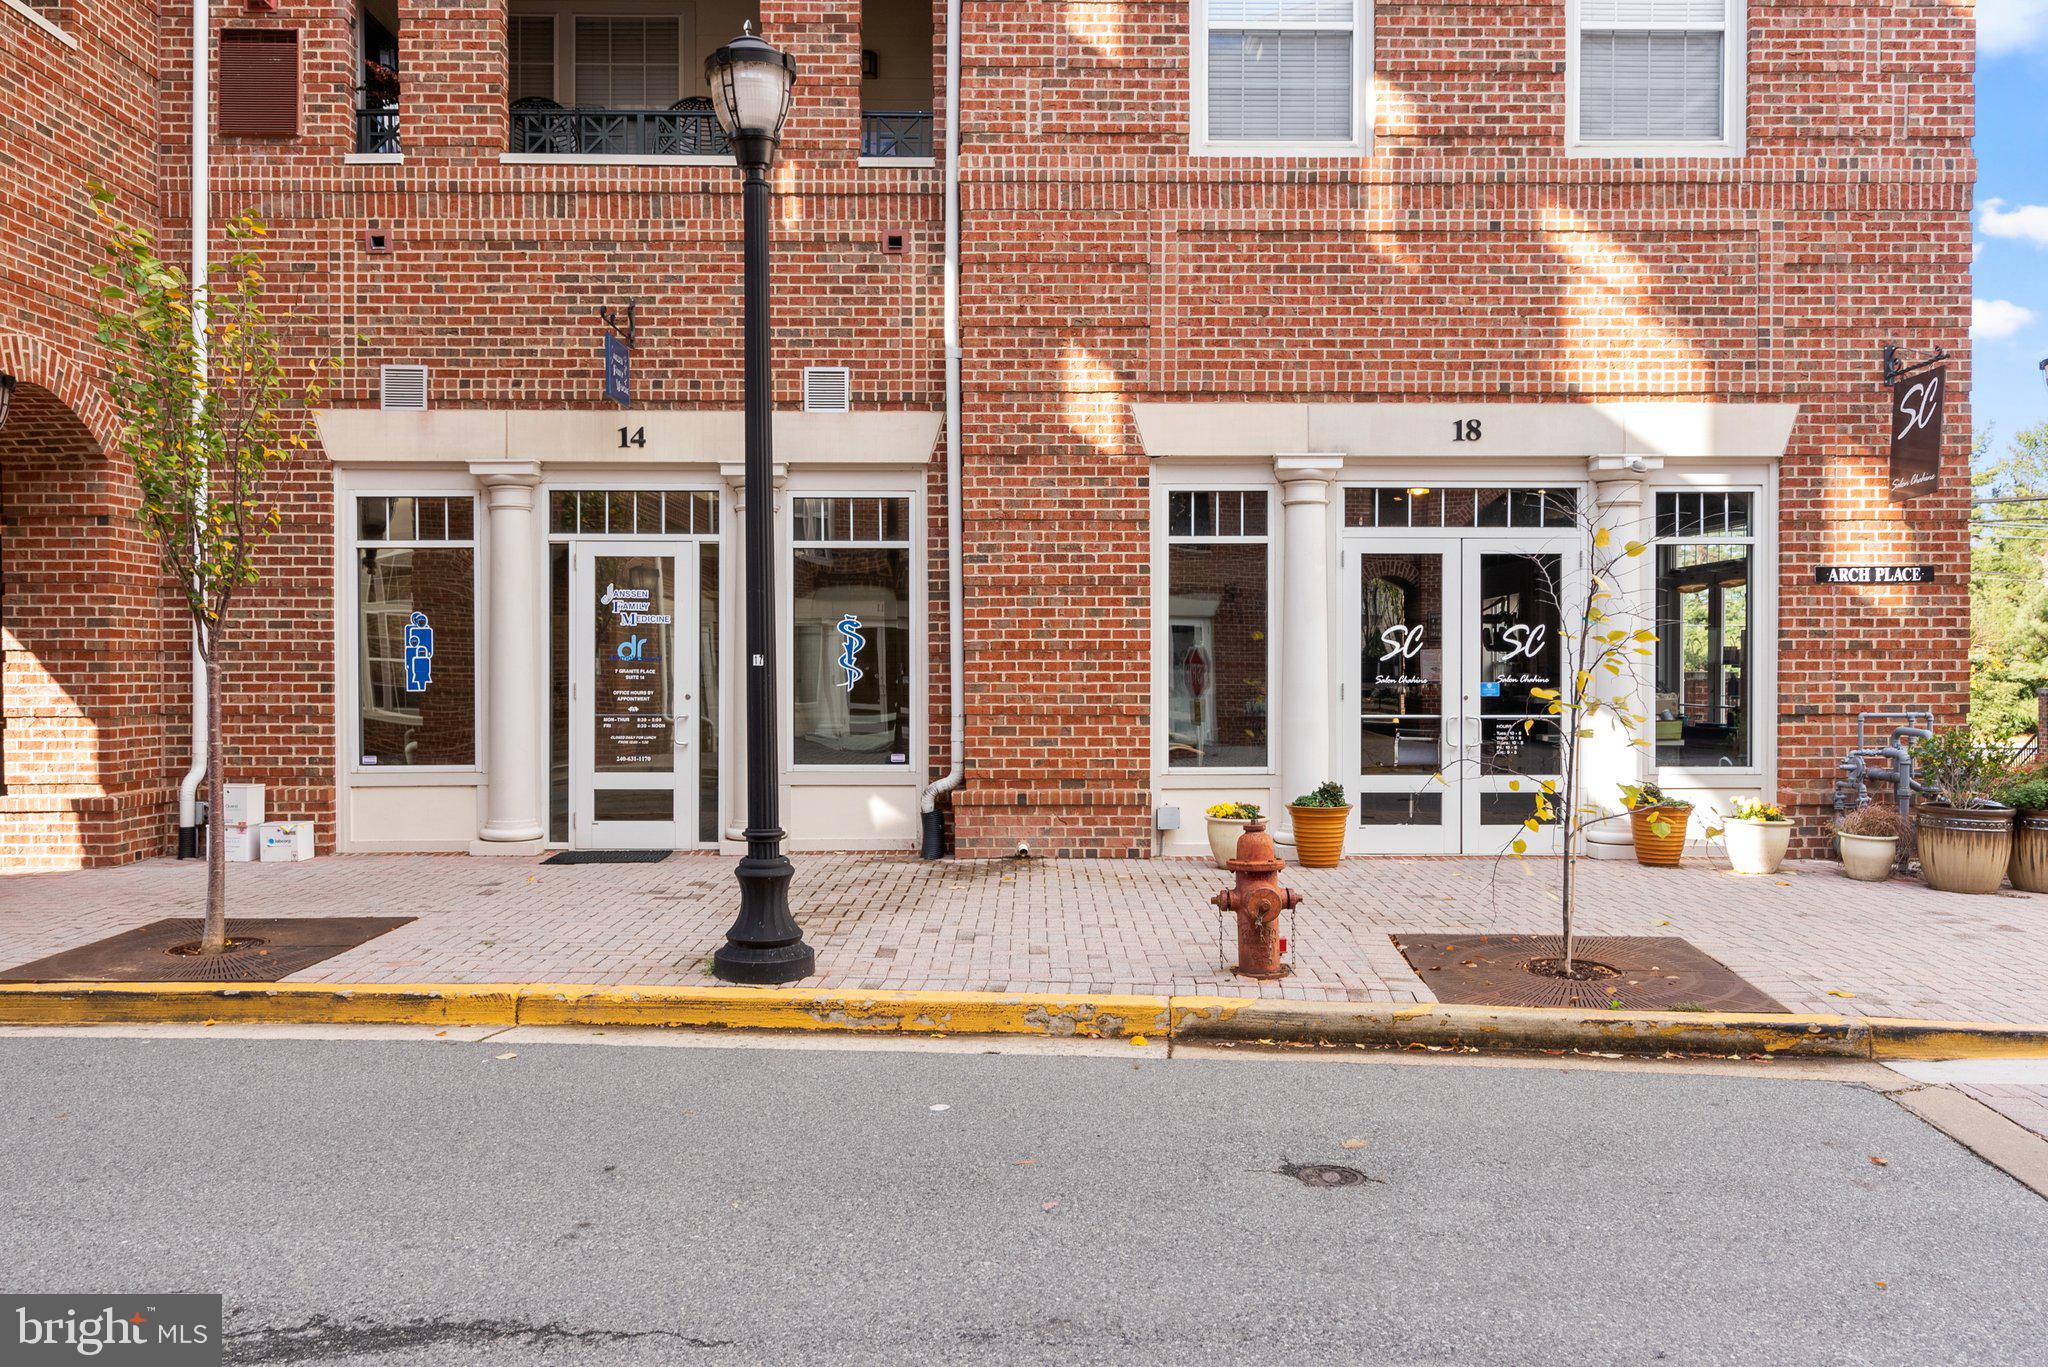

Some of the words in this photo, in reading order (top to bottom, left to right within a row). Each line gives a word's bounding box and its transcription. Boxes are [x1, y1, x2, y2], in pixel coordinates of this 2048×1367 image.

[1897, 376, 1938, 440] SC
[617, 426, 647, 448] 14
[1453, 419, 1482, 442] 18
[1891, 478, 1909, 492] Salon
[1828, 567, 1871, 582] ARCH
[1874, 567, 1921, 582] PLACE
[601, 583, 649, 605] JANSSEN
[612, 600, 650, 613] FAMILY
[620, 612, 671, 626] MEDICINE
[617, 634, 647, 661] dr
[1380, 624, 1424, 661] SC
[1502, 624, 1546, 660] SC
[1375, 674, 1397, 685] Salon
[1496, 674, 1518, 684] Salon
